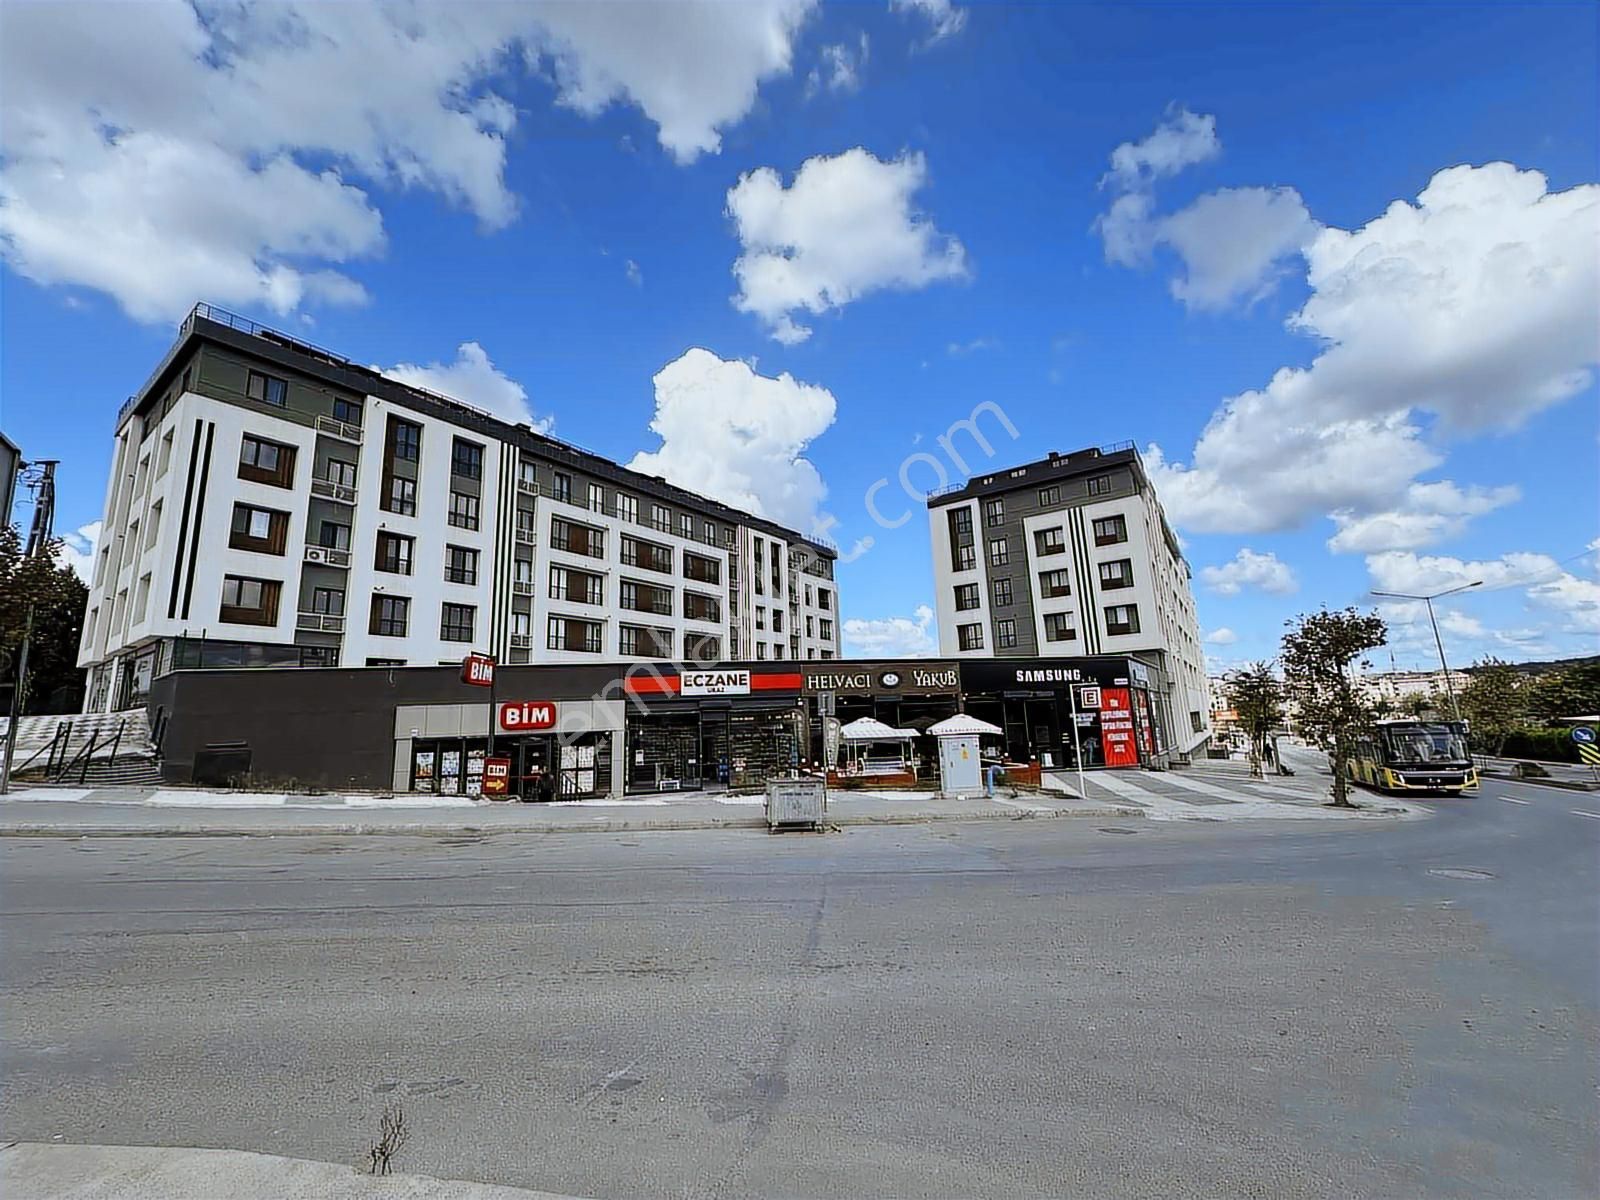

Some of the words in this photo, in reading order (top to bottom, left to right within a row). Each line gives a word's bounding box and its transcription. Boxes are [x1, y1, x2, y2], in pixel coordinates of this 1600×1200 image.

[470, 659, 493, 682] BİM
[683, 673, 748, 687] ECZANE
[807, 674, 871, 689] HELVACI
[913, 670, 957, 688] YAKUB
[1016, 669, 1081, 682] SAMSUNG
[505, 703, 550, 725] BİM
